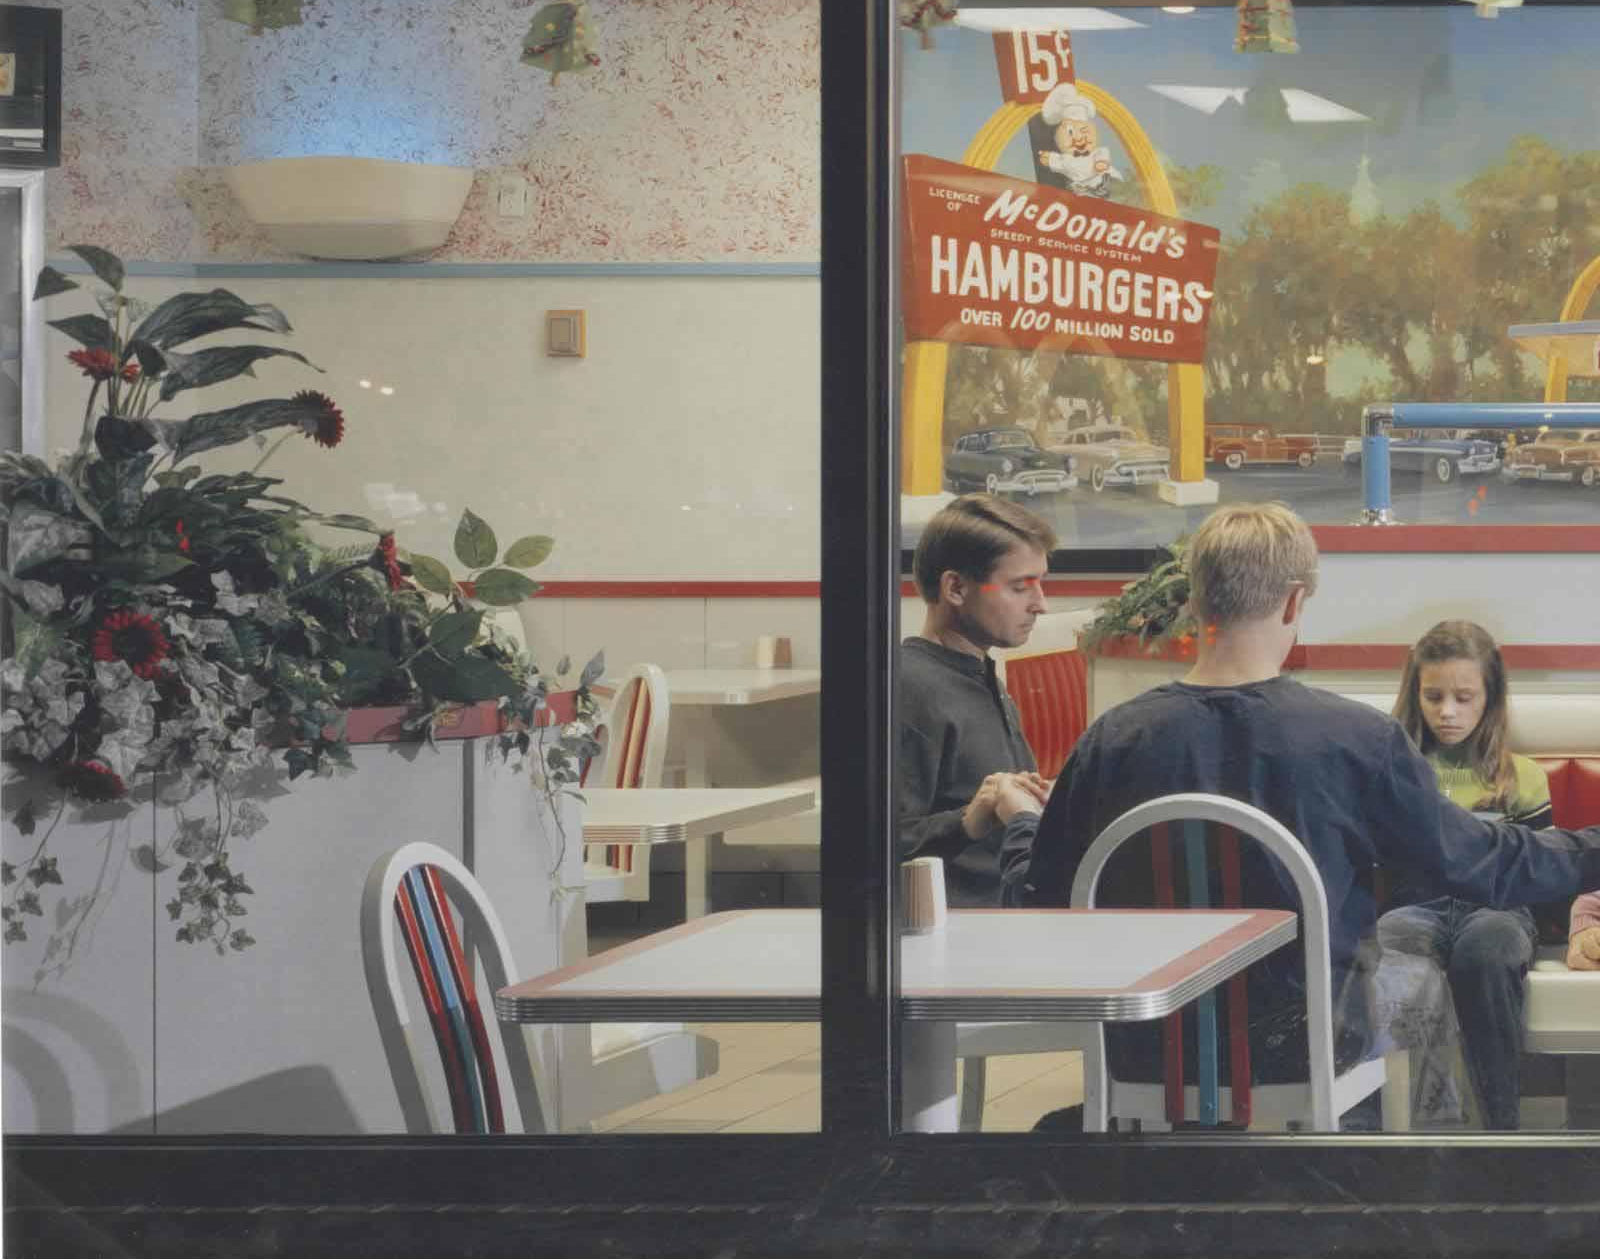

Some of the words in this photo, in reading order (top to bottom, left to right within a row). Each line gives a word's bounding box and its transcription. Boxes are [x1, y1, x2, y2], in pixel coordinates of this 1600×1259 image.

[946, 202, 962, 213] OF
[983, 189, 1188, 259] McDonald's
[1038, 238, 1089, 255] SERVICE
[1095, 247, 1142, 263] SYSTEM
[931, 234, 1204, 324] HAMBURGERS
[961, 308, 1003, 328] OVER
[1010, 307, 1051, 331] 100
[1055, 318, 1123, 340] MILLION
[1129, 325, 1175, 344] SOLD
